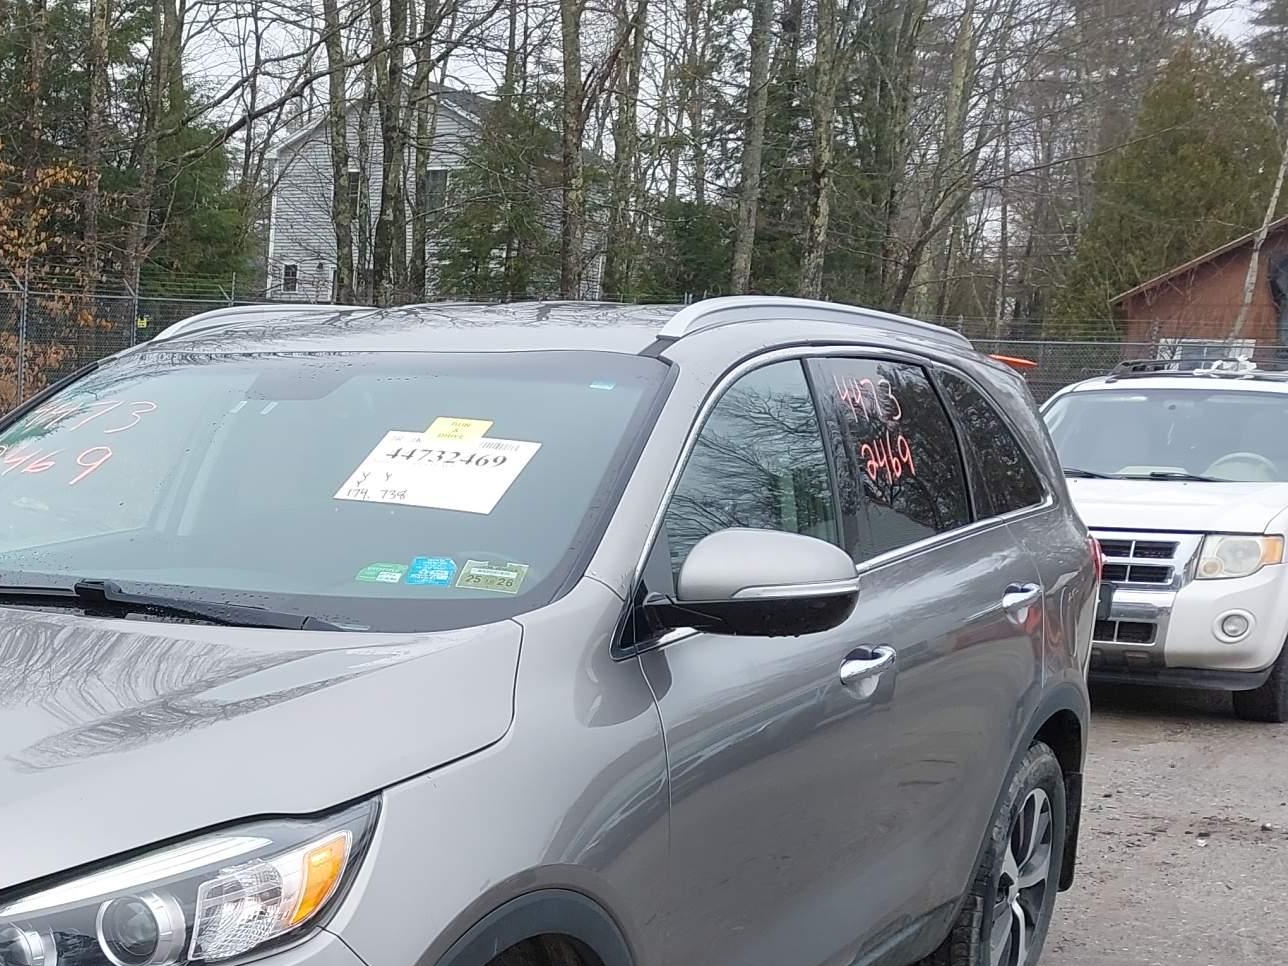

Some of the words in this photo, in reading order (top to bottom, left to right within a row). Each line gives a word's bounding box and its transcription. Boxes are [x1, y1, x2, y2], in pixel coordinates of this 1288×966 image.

[833, 375, 902, 423] 4473
[24, 400, 157, 434] 4473
[385, 447, 508, 468] 44732469
[860, 431, 916, 485] 2469
[464, 574, 482, 583] 25
[496, 577, 514, 587] 26
